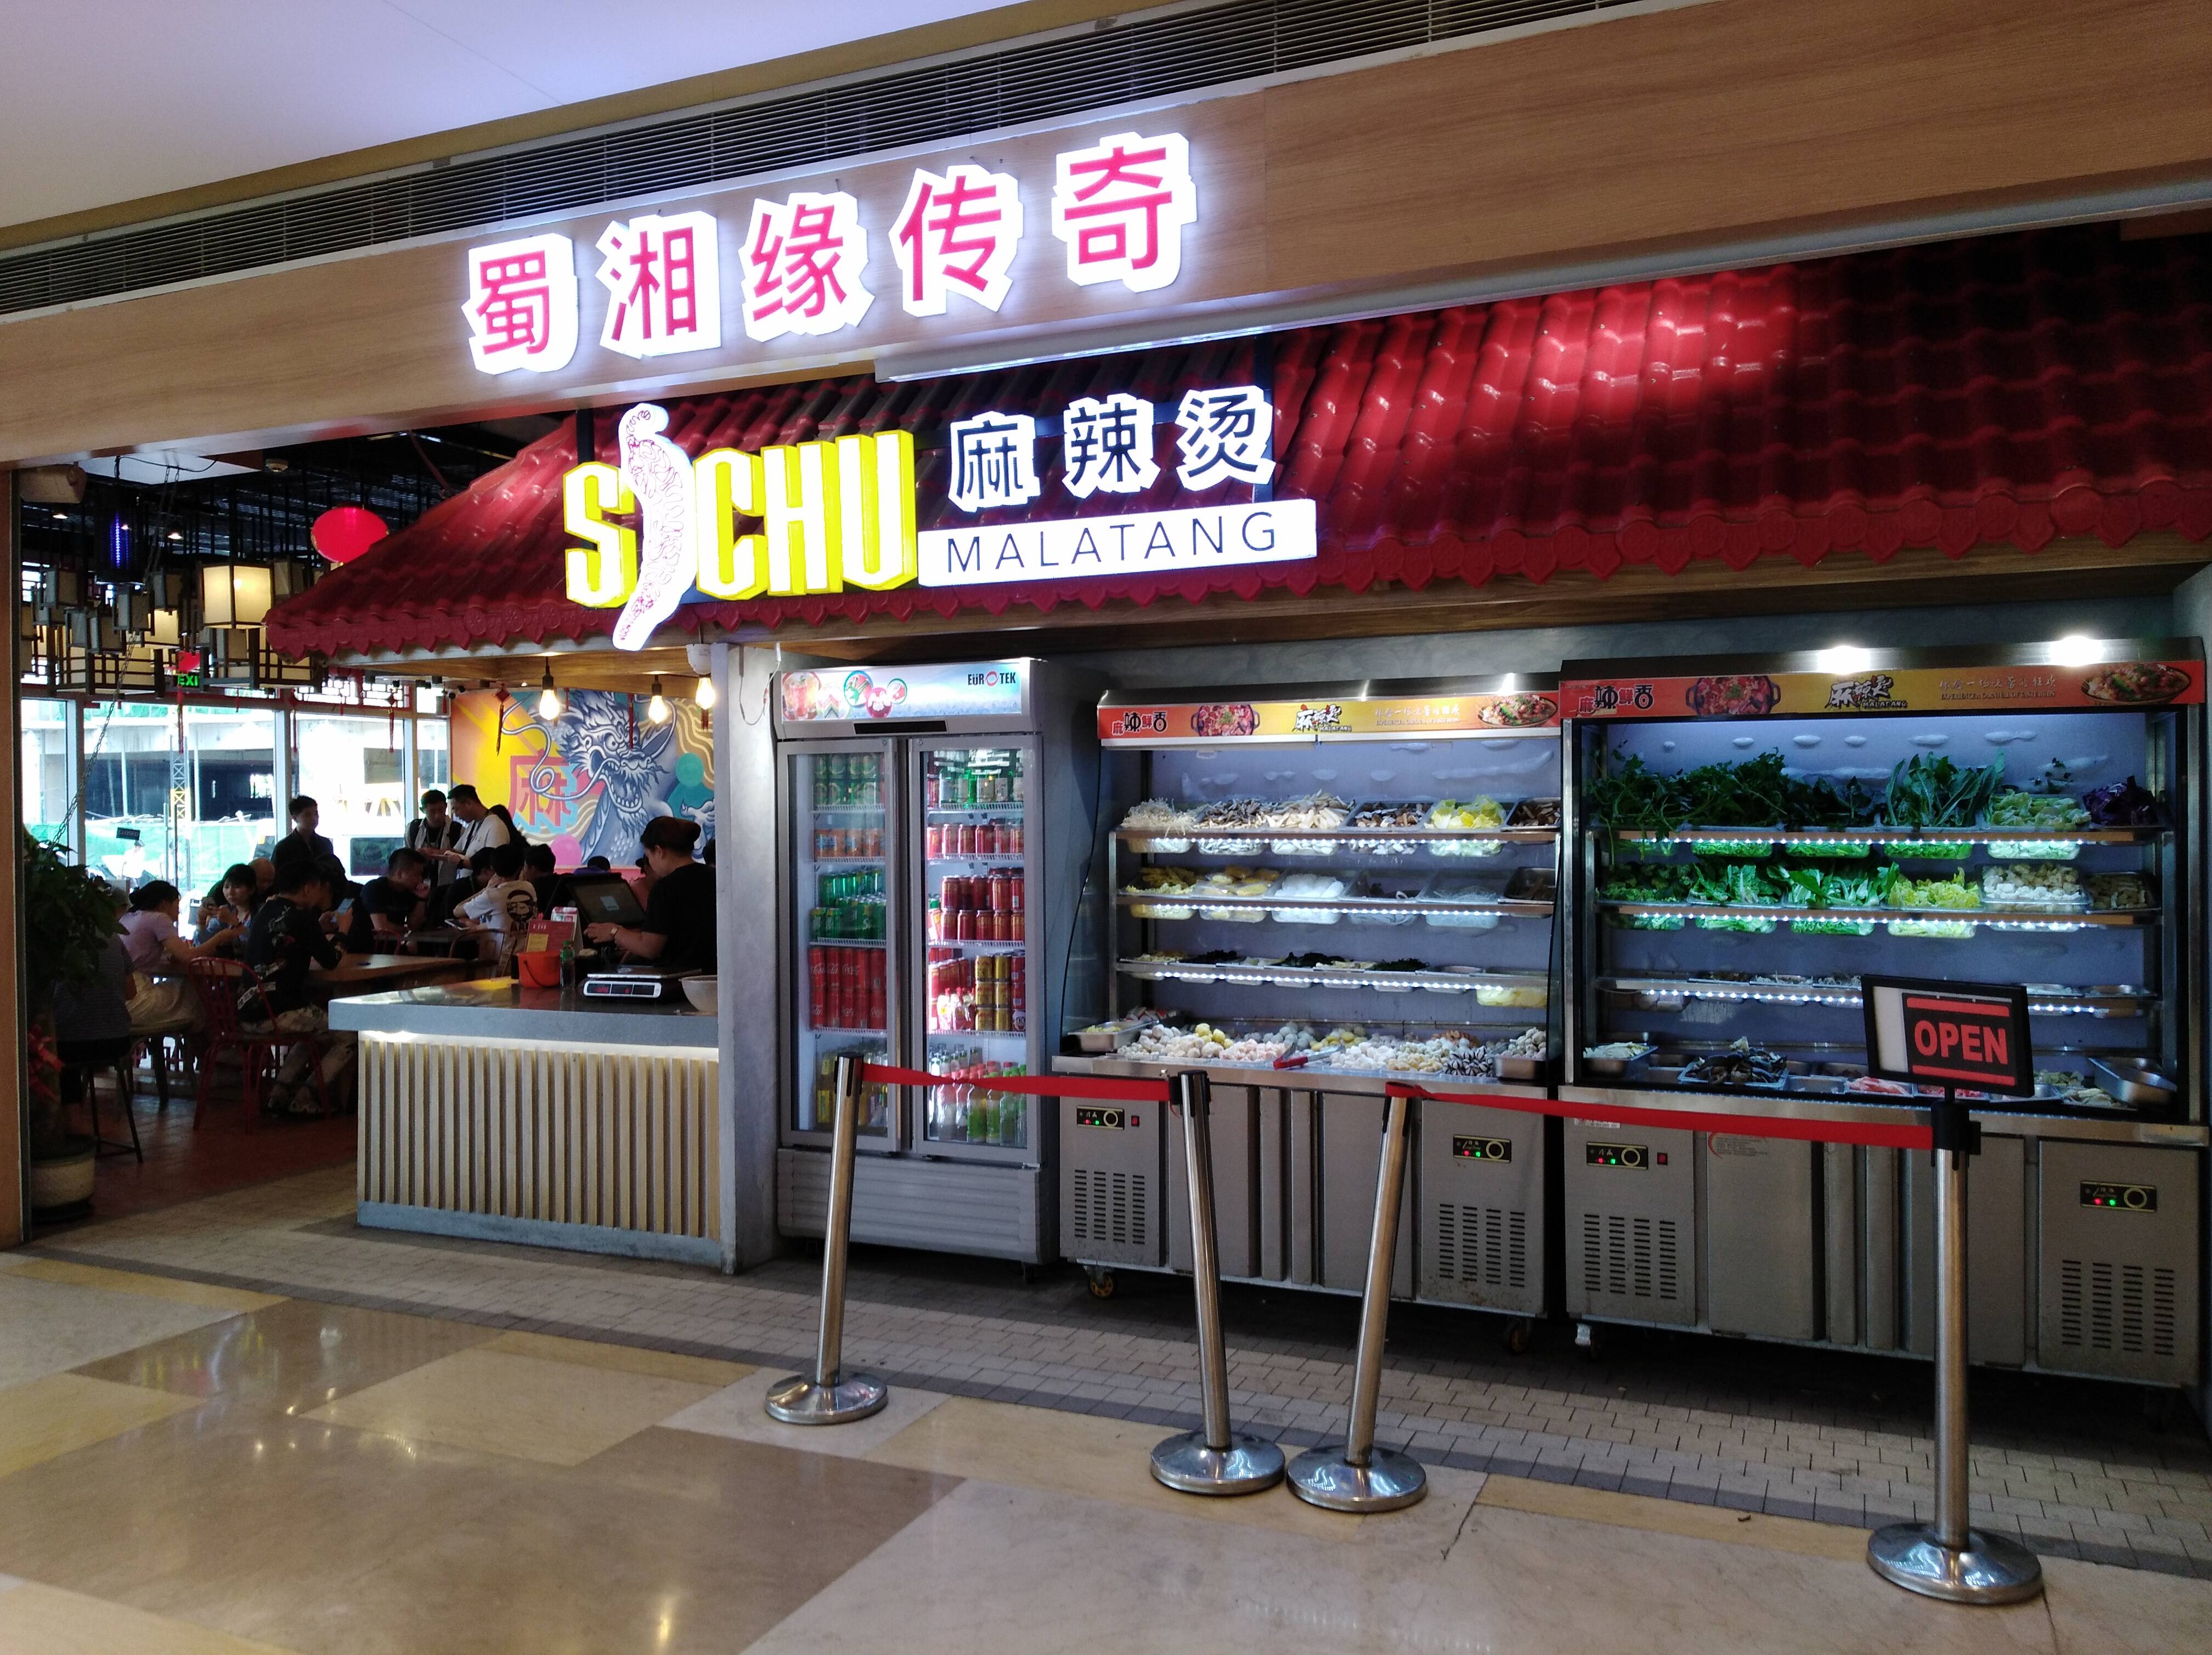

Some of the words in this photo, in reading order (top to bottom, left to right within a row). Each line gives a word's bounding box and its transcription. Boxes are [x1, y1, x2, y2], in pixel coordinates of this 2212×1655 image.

[473, 147, 1173, 356] 蜀湘缘传奇
[952, 391, 1266, 505] 麻辣烫
[945, 509, 1278, 574] MALATANG
[178, 674, 199, 686] EXI
[1914, 1020, 2008, 1065] OPEN
